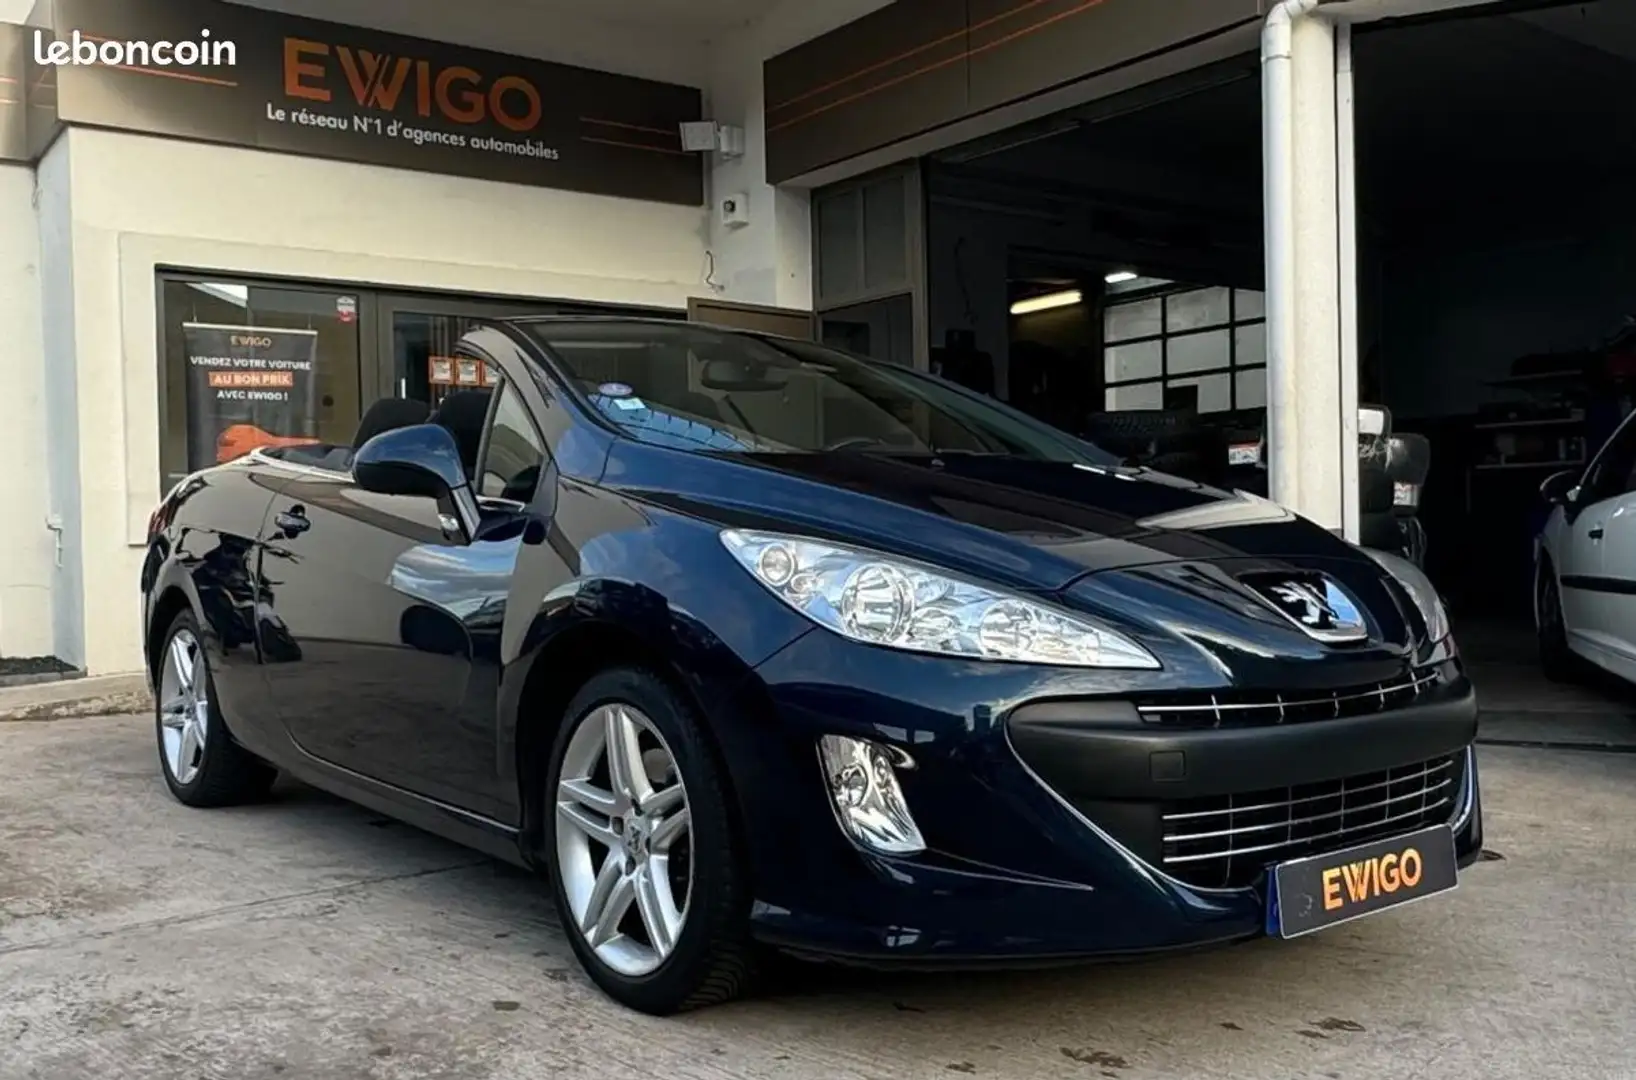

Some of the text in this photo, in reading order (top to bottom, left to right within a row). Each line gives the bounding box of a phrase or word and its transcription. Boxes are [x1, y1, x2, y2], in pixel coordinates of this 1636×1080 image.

[284, 37, 542, 132] EWIGO
[266, 102, 286, 121] Le
[291, 108, 348, 130] réseau
[386, 119, 466, 146] d'agences
[470, 136, 560, 160] automobiles
[230, 334, 272, 348] EWIGO
[190, 355, 312, 371] VENDEZ VOTRE VOITURE
[213, 374, 232, 385] AU
[217, 389, 246, 400] AVEC
[1322, 848, 1423, 911] EWIGO
